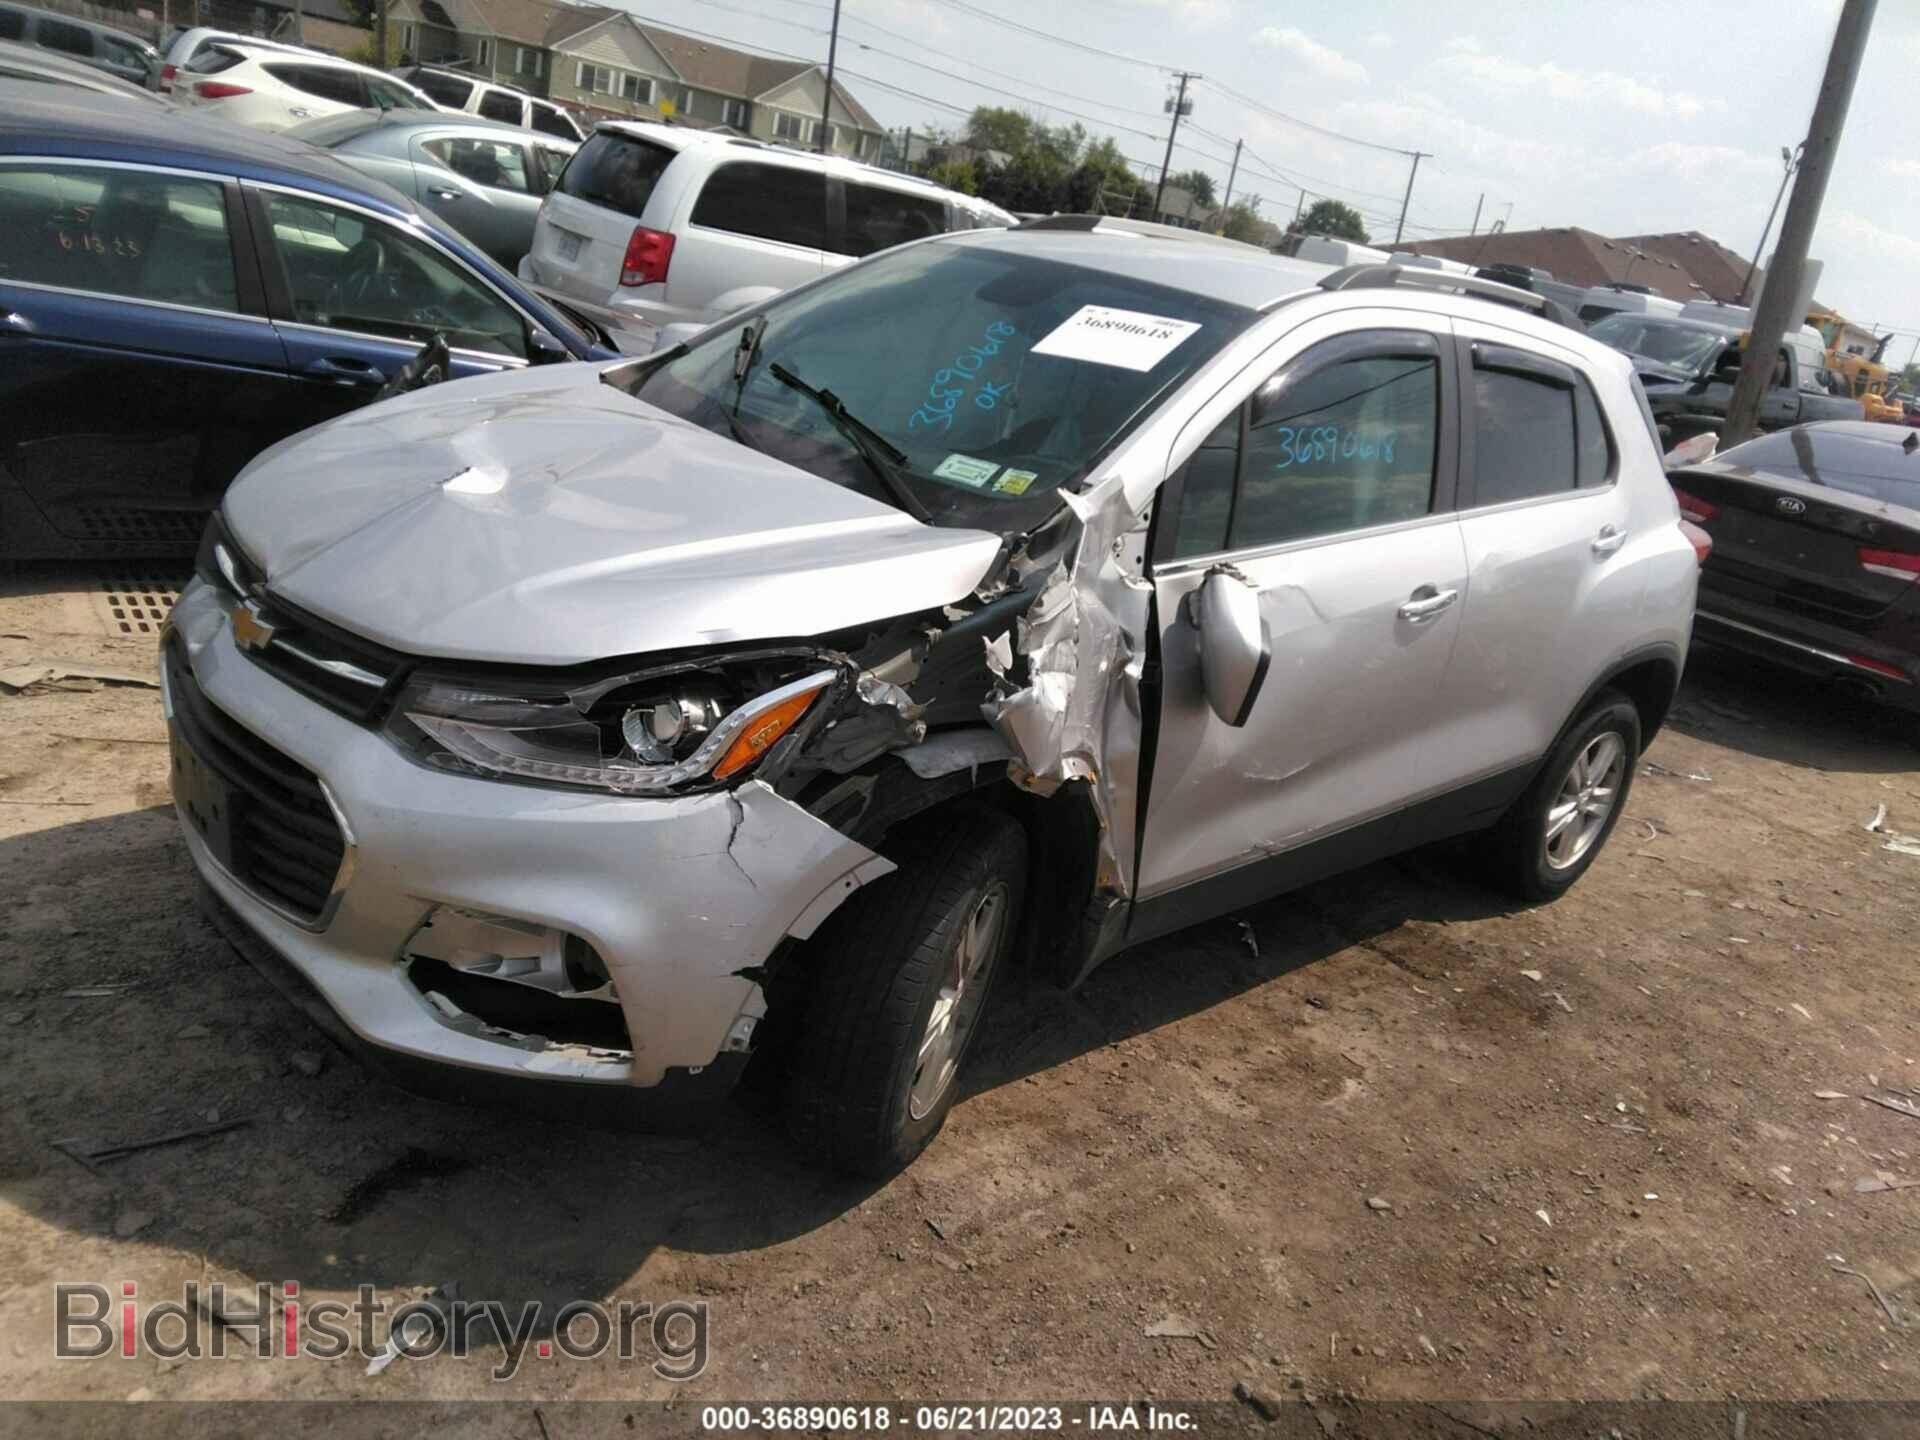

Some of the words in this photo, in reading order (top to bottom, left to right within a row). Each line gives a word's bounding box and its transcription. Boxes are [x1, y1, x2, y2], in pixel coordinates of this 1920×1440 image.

[1077, 316, 1173, 339] 36890618
[908, 320, 1016, 431] 36890618
[976, 381, 1012, 410] OK
[1276, 426, 1398, 469] 36890618
